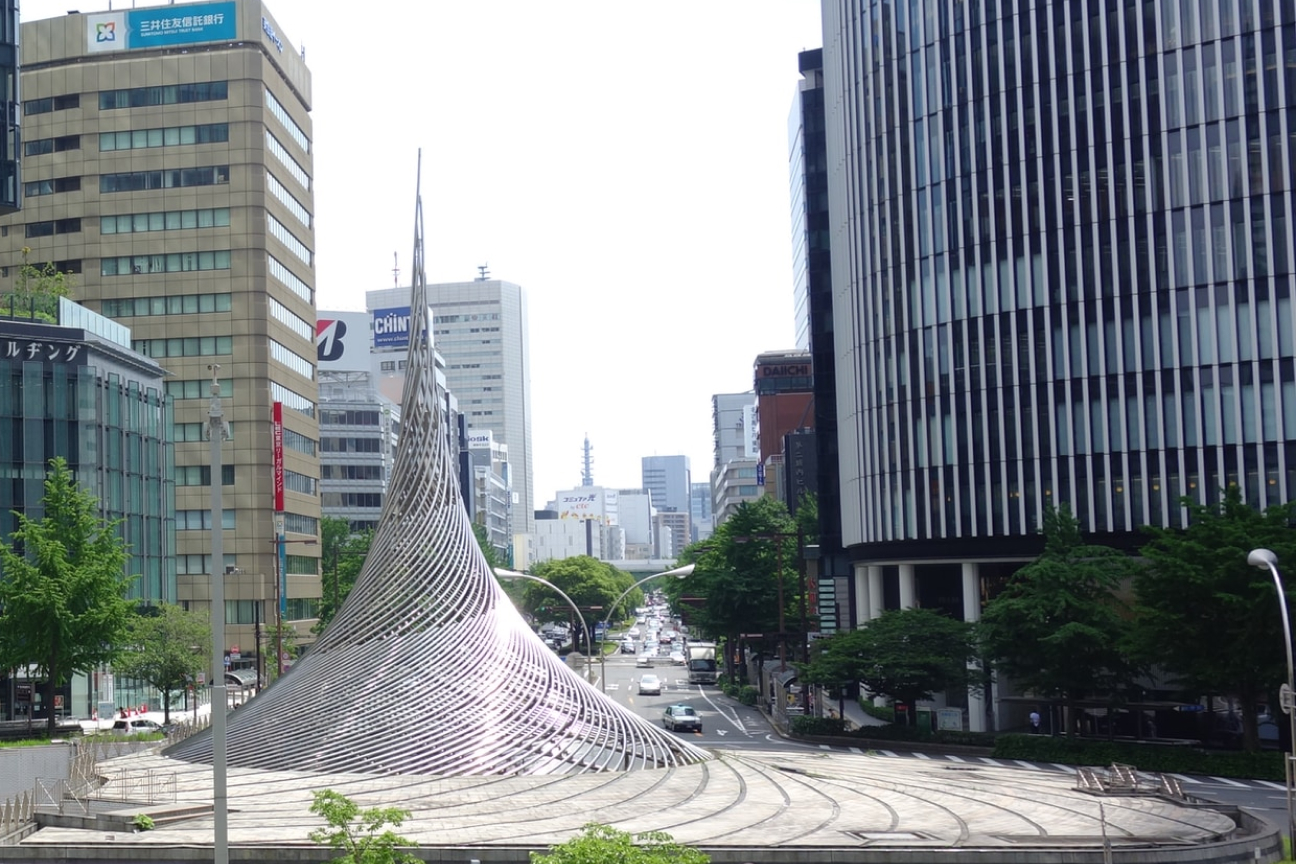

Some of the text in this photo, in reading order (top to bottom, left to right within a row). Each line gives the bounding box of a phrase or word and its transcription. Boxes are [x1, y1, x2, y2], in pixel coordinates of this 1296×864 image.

[140, 13, 224, 32] 三井住友信託銀行
[763, 365, 808, 376] DAIICHI
